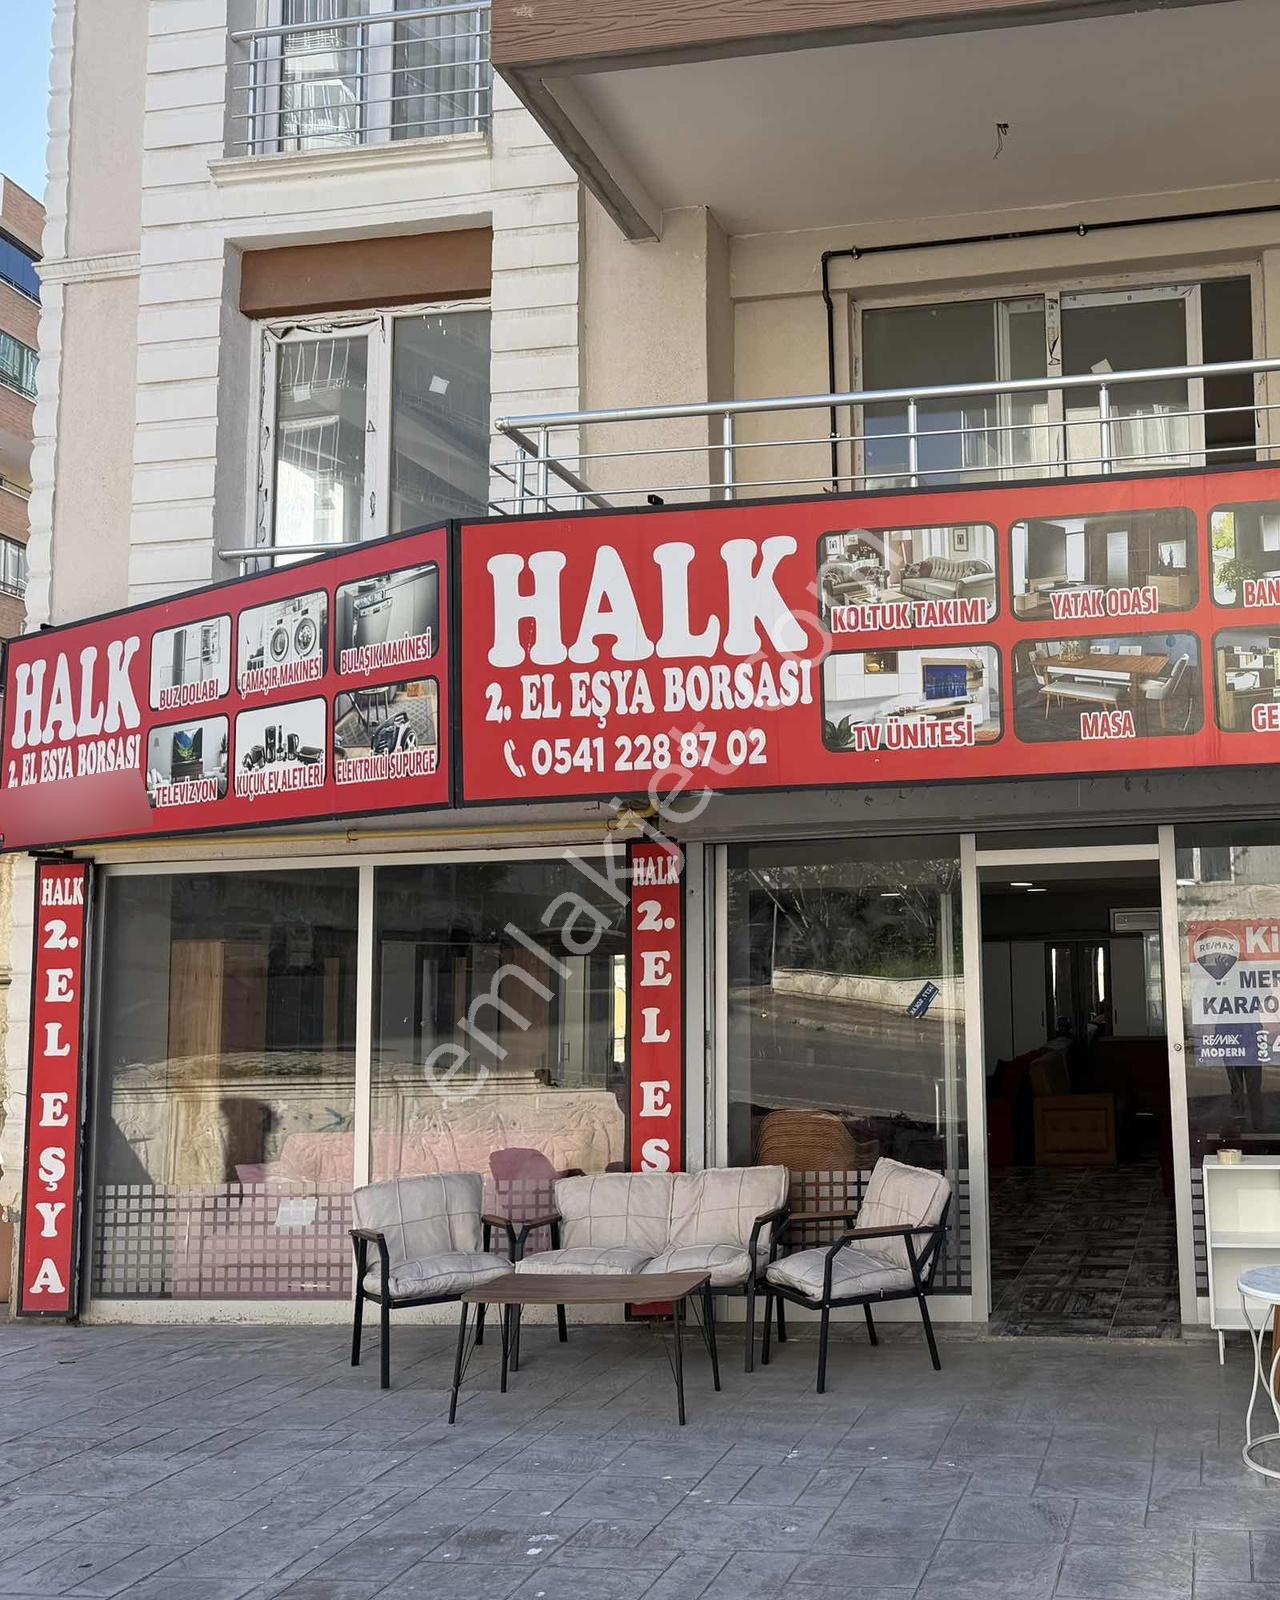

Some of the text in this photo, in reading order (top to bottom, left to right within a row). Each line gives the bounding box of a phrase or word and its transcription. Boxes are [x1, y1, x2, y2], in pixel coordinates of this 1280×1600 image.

[487, 535, 808, 667] HALK
[831, 597, 987, 633] KOLTUK TAKIMI
[1050, 586, 1158, 620] YATAK ODASI
[11, 636, 141, 749] HALK
[158, 679, 220, 711] BUZ DOLABI
[484, 659, 813, 728] 2. EL EŞYA BORSASI
[851, 712, 975, 751] TV ÜNİTESİ
[1081, 710, 1136, 740] MASA
[21, 752, 37, 786] EL
[77, 734, 141, 777] BORSASI
[531, 728, 767, 776] 0541 228 87 02
[155, 776, 218, 808] TELEVİZYON
[632, 855, 680, 886] HALK
[41, 877, 84, 906] HALK
[637, 899, 676, 932] 2.
[43, 919, 79, 950] 2.
[1199, 941, 1234, 952] RE/MAX
[1202, 995, 1280, 1016] KARAO
[1201, 1047, 1246, 1058] MODERN
[1202, 1034, 1240, 1046] RE/MAX
[1256, 1030, 1271, 1062] (362)
